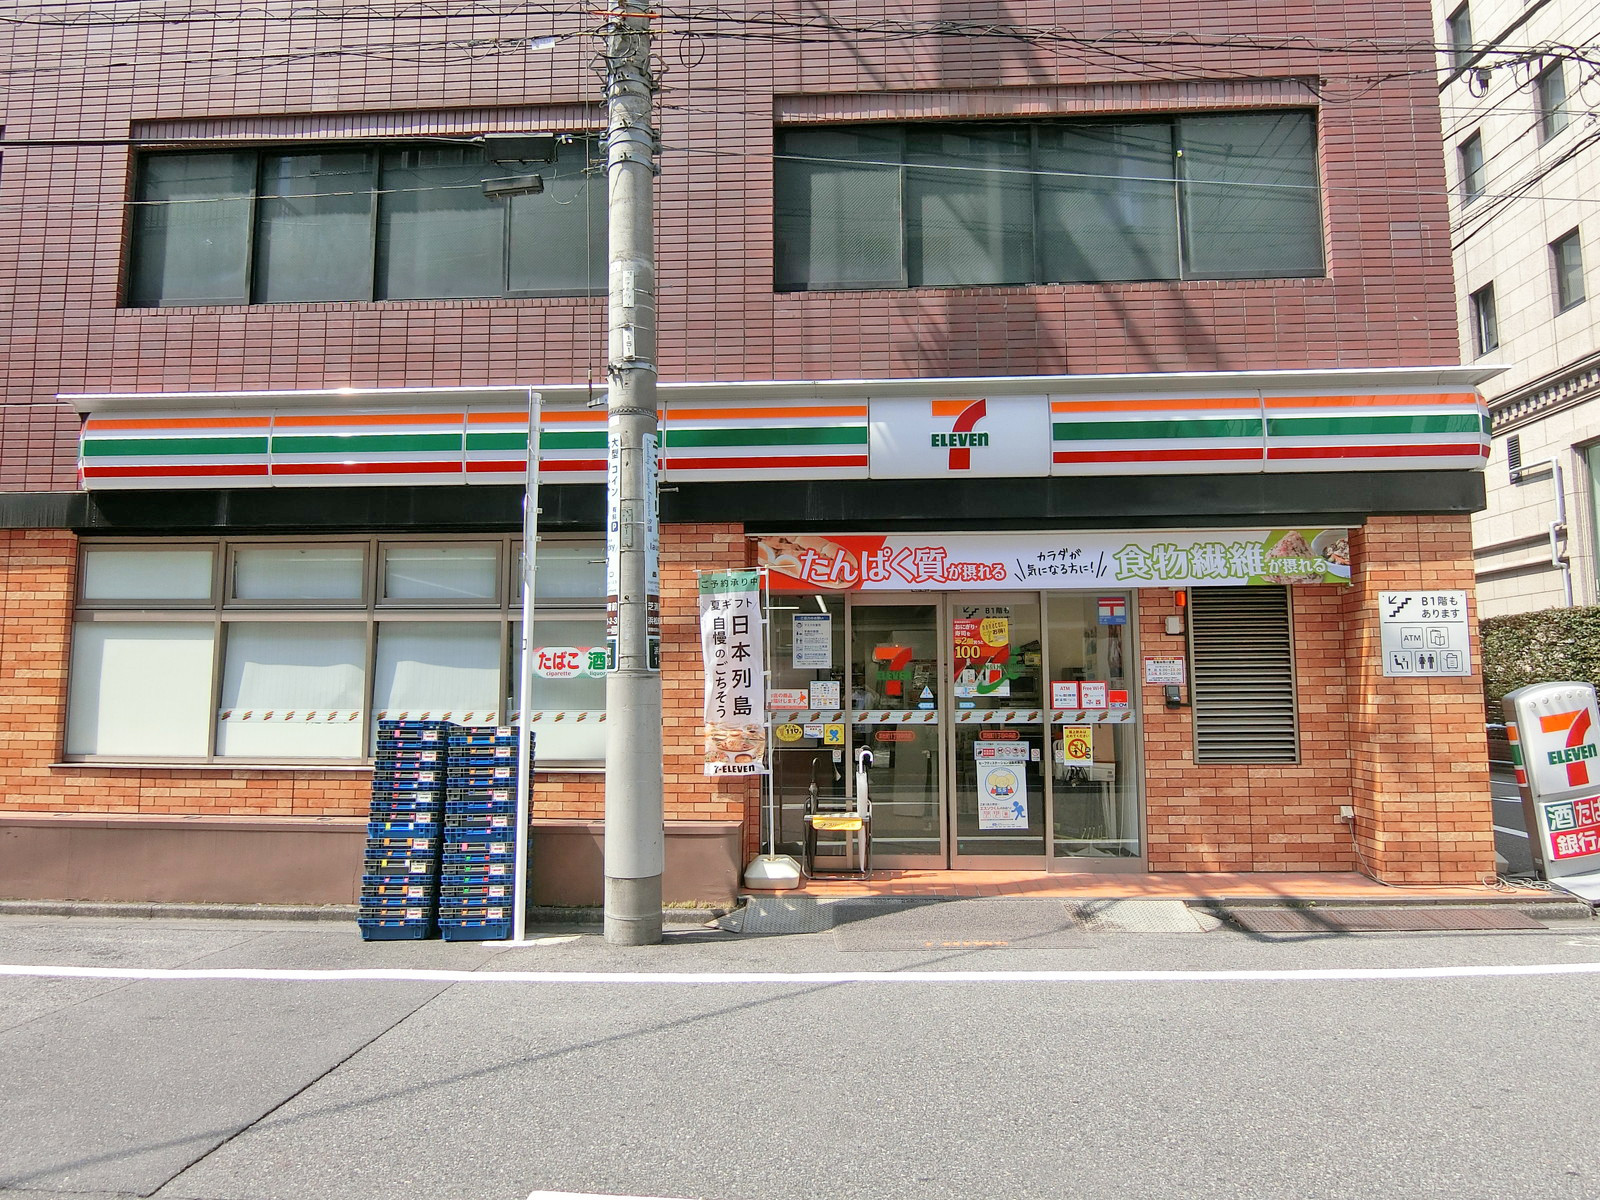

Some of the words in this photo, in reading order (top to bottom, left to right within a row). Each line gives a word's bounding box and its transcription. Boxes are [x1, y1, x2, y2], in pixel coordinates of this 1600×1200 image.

[932, 399, 986, 469] 7
[800, 546, 1007, 584] たんぱく質が摂れる
[1037, 548, 1082, 561] カラダが
[1113, 542, 1328, 582] 食物繊維が摂れる
[701, 577, 758, 589] ご予約承り中
[1421, 596, 1458, 606] B1階も
[1421, 609, 1460, 618] あります
[538, 651, 580, 670] たばこ
[587, 651, 606, 670] 酒
[955, 645, 981, 659] 100
[712, 617, 728, 719] 自慢のごちそう
[731, 615, 752, 716] 日本列島
[1539, 707, 1591, 787] 7
[1547, 804, 1575, 830] 酒
[1556, 831, 1600, 855] 銀行
